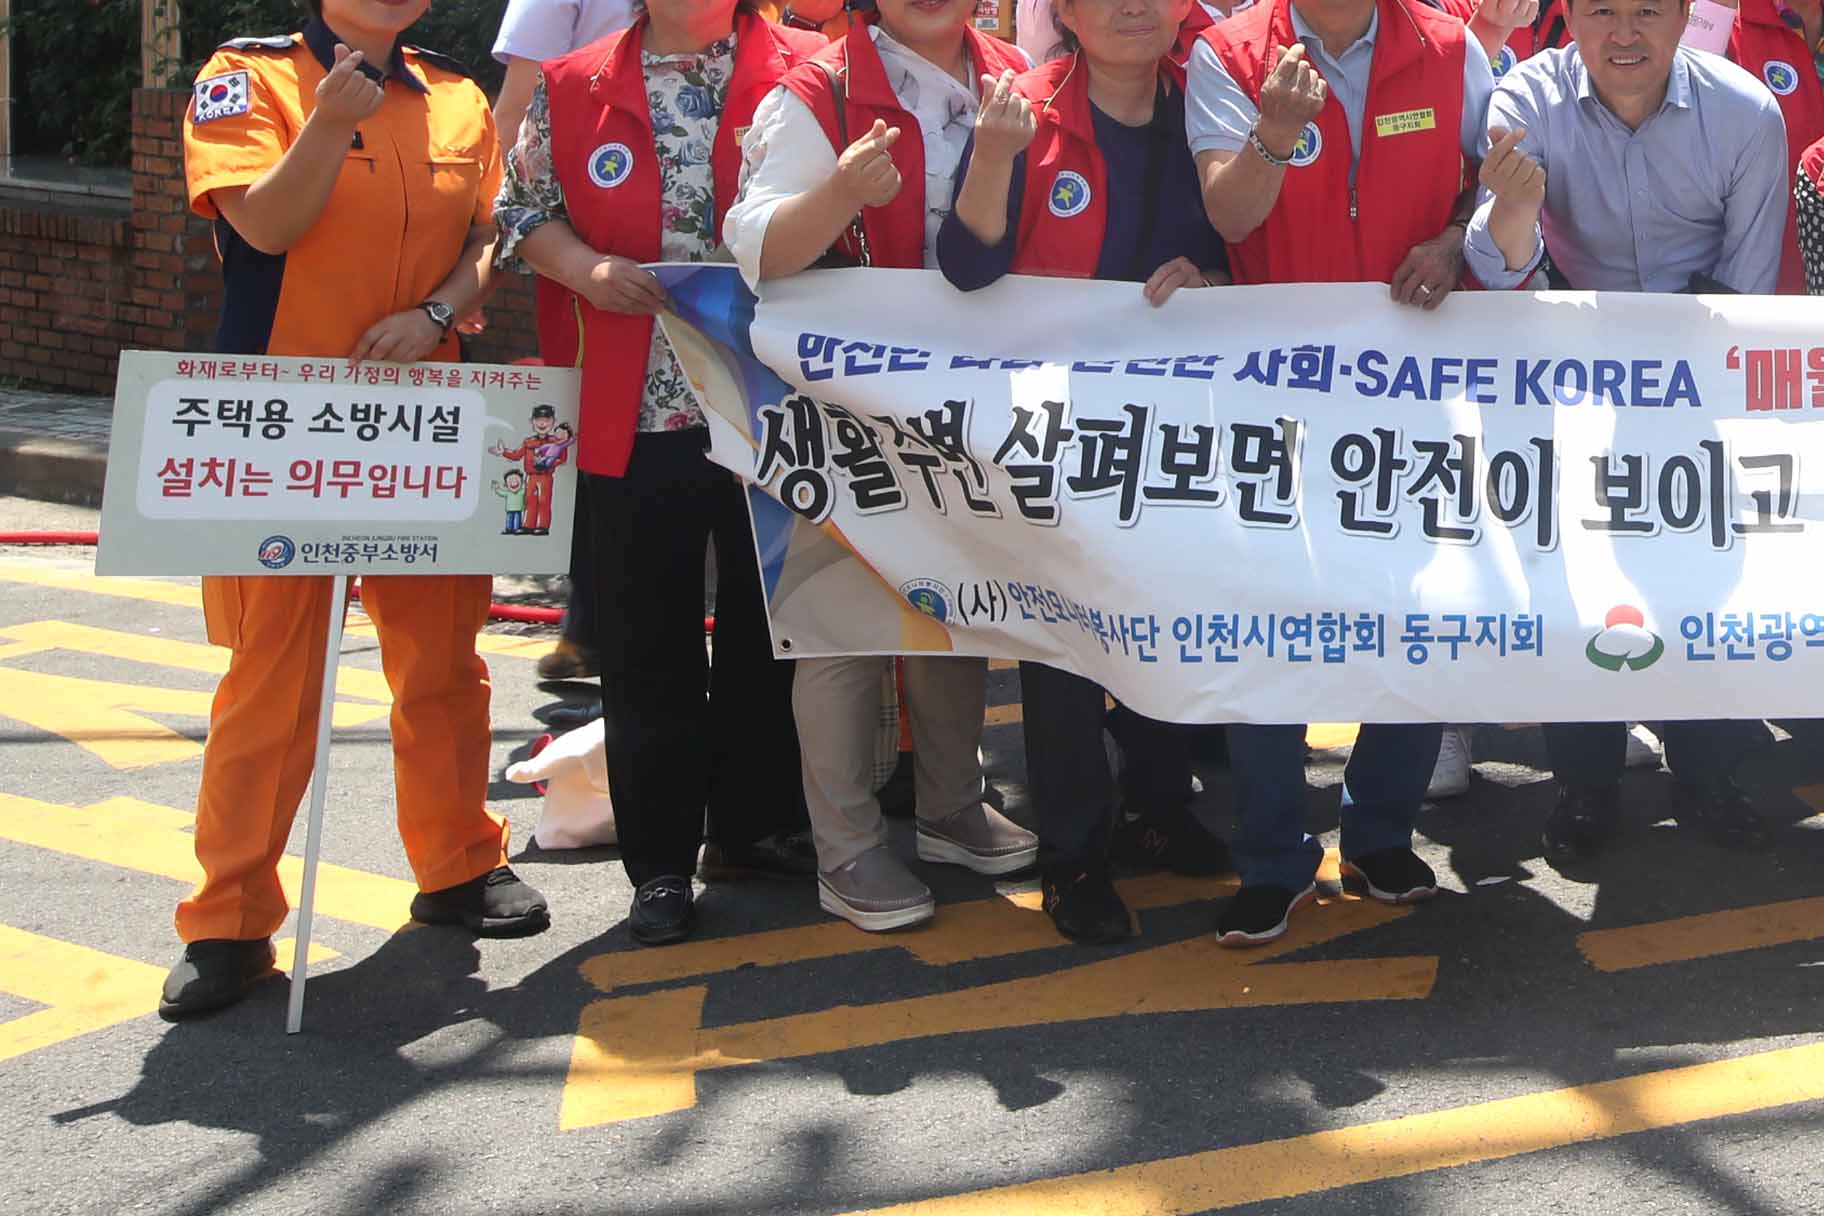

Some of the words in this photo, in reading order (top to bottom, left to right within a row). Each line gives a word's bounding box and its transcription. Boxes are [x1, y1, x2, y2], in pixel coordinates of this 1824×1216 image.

[297, 362, 336, 383] 우리
[344, 362, 400, 386] 가정의
[408, 366, 463, 388] 행복을
[469, 369, 543, 391] 지켜주는
[1513, 357, 1702, 409] KOREA
[172, 398, 294, 440] 주택용
[307, 402, 462, 443] 소방시설
[157, 457, 274, 498] 설치는
[286, 459, 467, 499] 의무입니다
[757, 395, 1001, 522] 생활주변
[993, 397, 1303, 527] 살펴보면
[1331, 424, 1559, 550] 안전이
[1581, 437, 1805, 550] 보이고
[301, 542, 438, 564] 인천중부소방서
[1170, 612, 1386, 665] 인천시연합회
[1400, 612, 1545, 665] 동구지회
